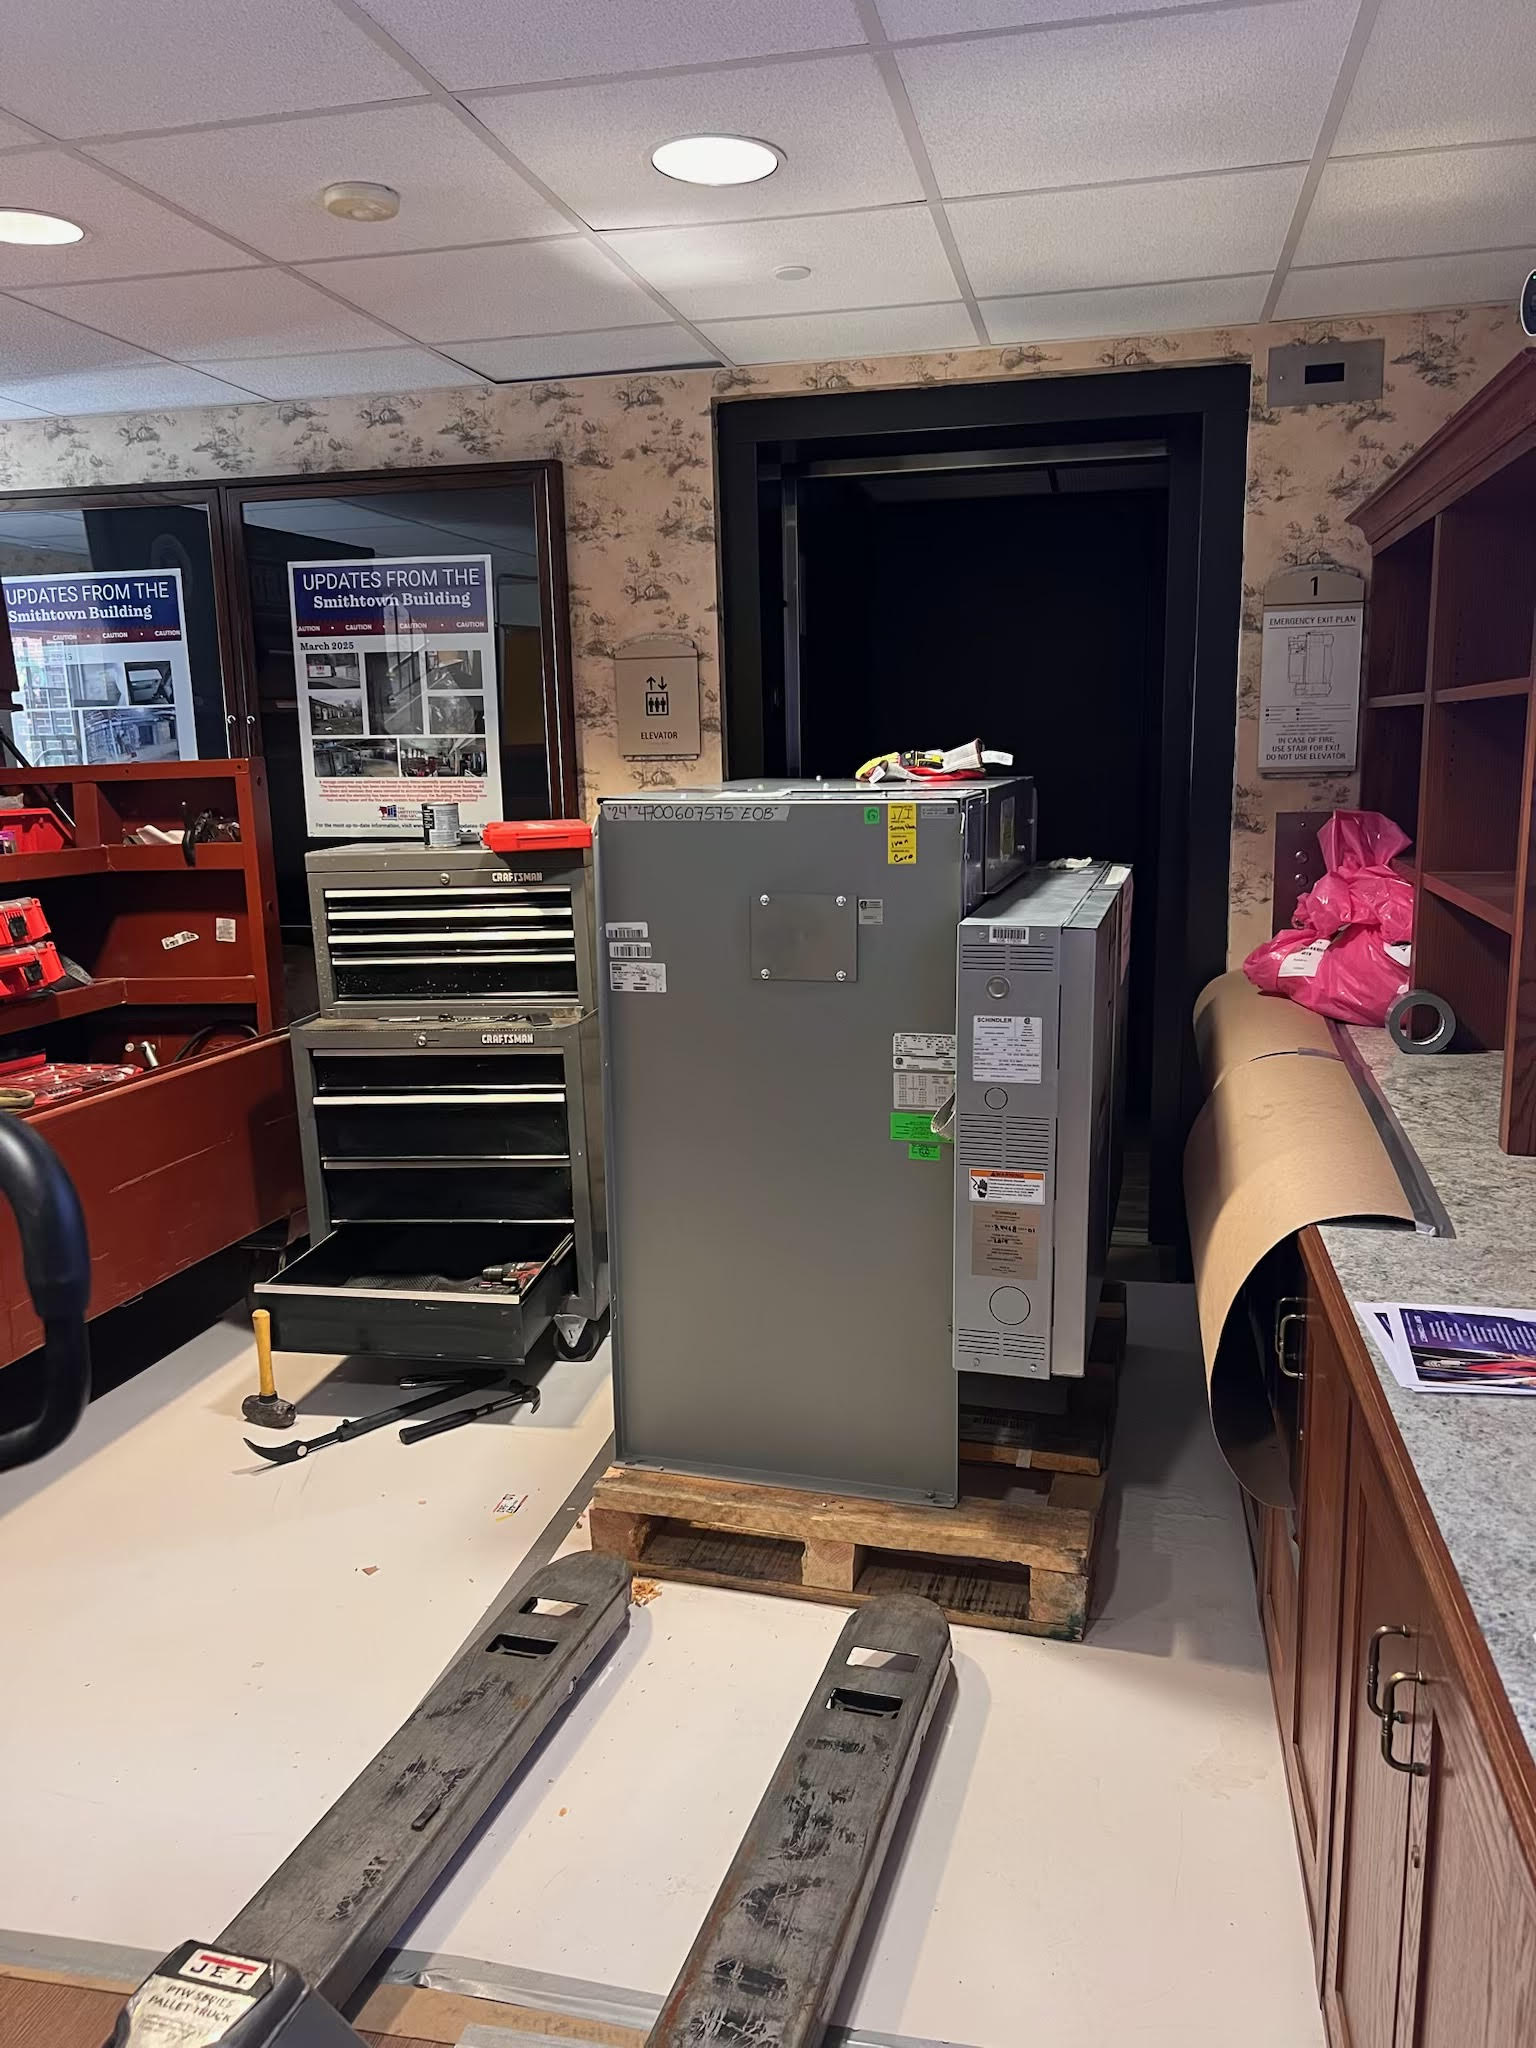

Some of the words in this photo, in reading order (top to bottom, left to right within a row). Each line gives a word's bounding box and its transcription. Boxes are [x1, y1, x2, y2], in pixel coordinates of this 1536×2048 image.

[303, 571, 381, 591] UPDATES
[386, 569, 438, 587] FROM
[442, 568, 480, 585] THE
[1310, 575, 1319, 597] 1
[5, 586, 78, 605] UPDATES
[82, 584, 129, 601] FROM
[134, 581, 169, 598] THE
[313, 594, 399, 609] Smithtown
[403, 591, 471, 608] Building
[9, 608, 87, 623] Smithtown
[88, 605, 153, 620] Building
[1269, 616, 1315, 626] EMERGENCY
[1317, 616, 1334, 624] EXIT
[1336, 615, 1356, 624] PLAN
[300, 642, 330, 651] March
[332, 641, 354, 650] 2025
[640, 731, 678, 740] ELEVATOR
[1309, 752, 1346, 760] ELEVATOR
[491, 872, 543, 882] CRAFTSMAN
[976, 1016, 1012, 1024] SCHINDLER
[481, 1034, 534, 1044] CRAFTSMAN
[190, 1963, 253, 1985] JET
[166, 1985, 195, 1998] PTW
[148, 1995, 192, 2012] PALLET
[193, 2006, 234, 2023] TRUCK
